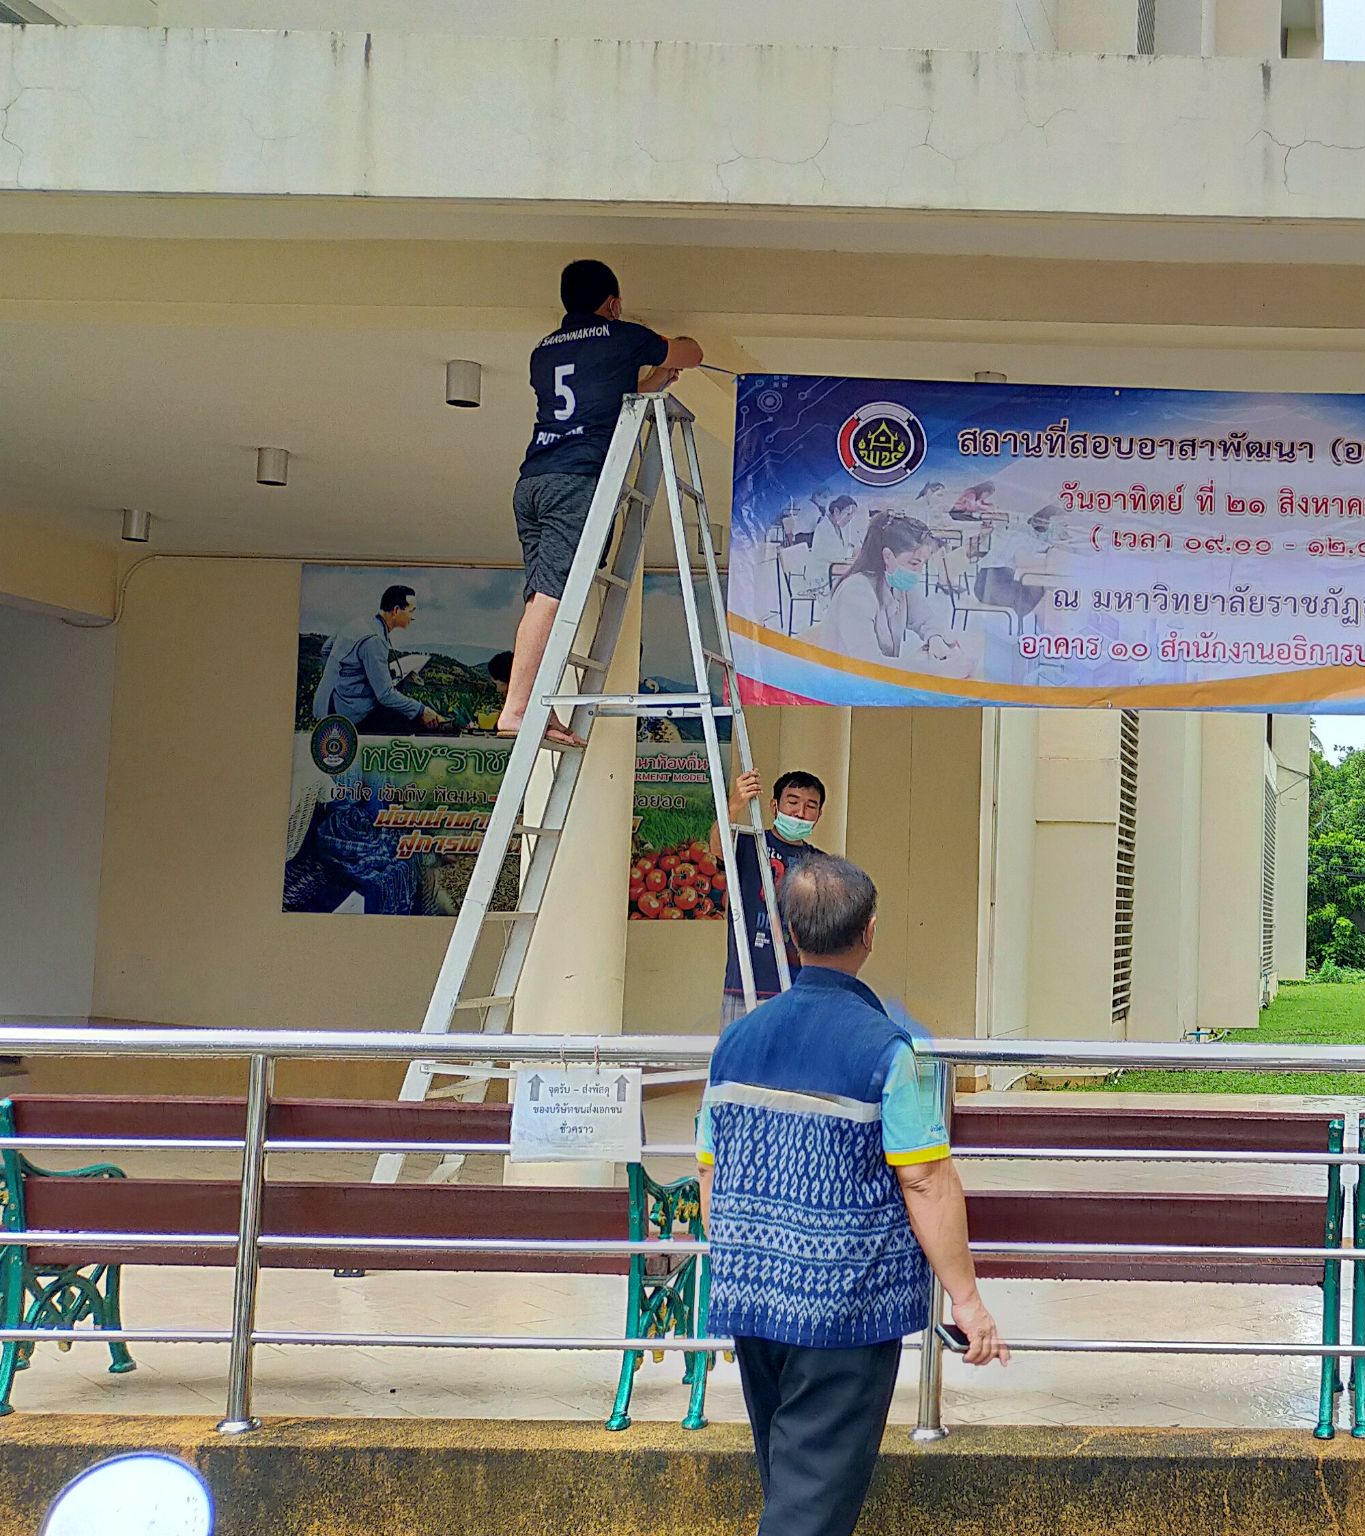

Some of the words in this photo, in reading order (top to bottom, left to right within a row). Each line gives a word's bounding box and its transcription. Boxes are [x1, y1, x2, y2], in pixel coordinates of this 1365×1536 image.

[554, 363, 576, 421] 5
[958, 419, 1314, 463] สถานที่สอบอาสาพัฒนา
[1059, 481, 1184, 512] วันอาทิตย์
[1196, 479, 1215, 514] ที่
[1226, 493, 1266, 515] ๒๑
[1184, 534, 1272, 555] ๐๙.๐๐
[1054, 588, 1079, 609] ณ
[1021, 634, 1101, 659] อาคาร
[1110, 642, 1150, 659] ๑๐
[363, 741, 511, 774] พลัง“ราช
[672, 773, 709, 783] MODEL
[331, 781, 372, 801] เข้าใจ
[378, 783, 426, 802] เข้าถึง
[548, 1083, 570, 1097] จุดรับ
